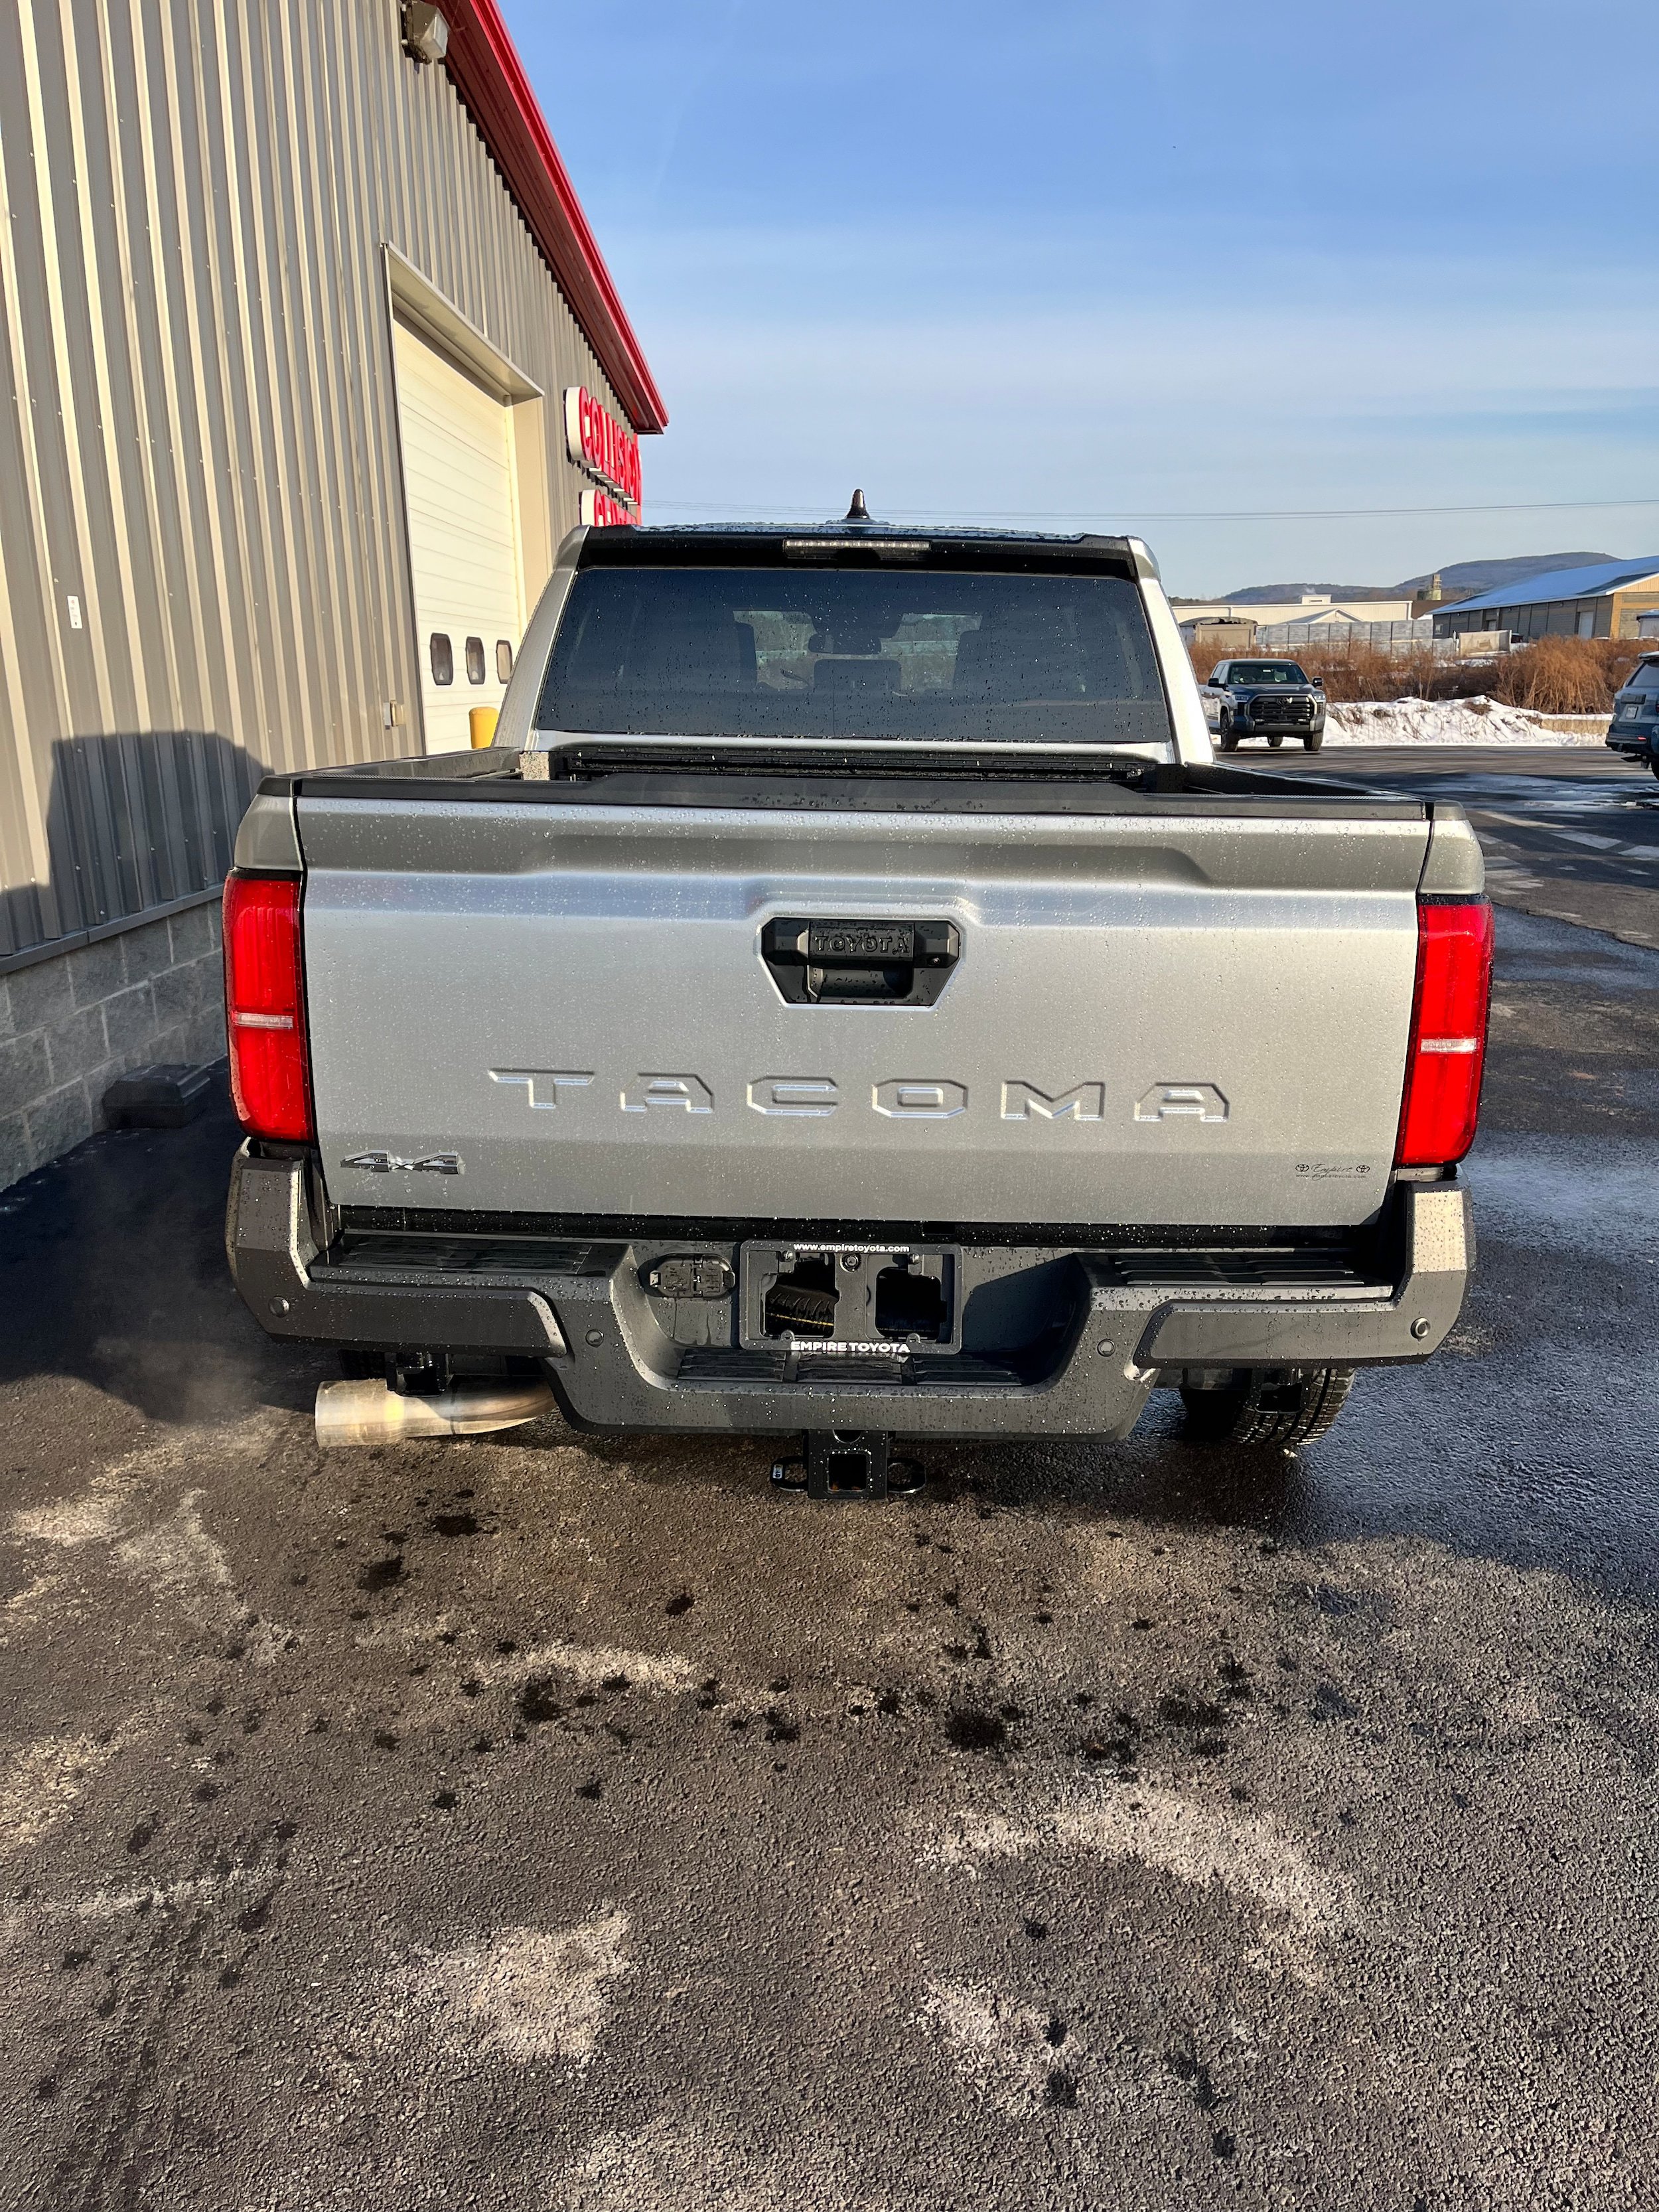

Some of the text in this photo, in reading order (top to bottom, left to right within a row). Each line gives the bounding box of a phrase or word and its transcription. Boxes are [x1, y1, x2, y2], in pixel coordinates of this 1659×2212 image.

[814, 935, 909, 954] TOYOTA
[488, 1068, 1230, 1122] TACOMA
[794, 1243, 910, 1253] www.empiretoyota.com
[790, 1341, 911, 1353] EMPIRE TOYOTA
